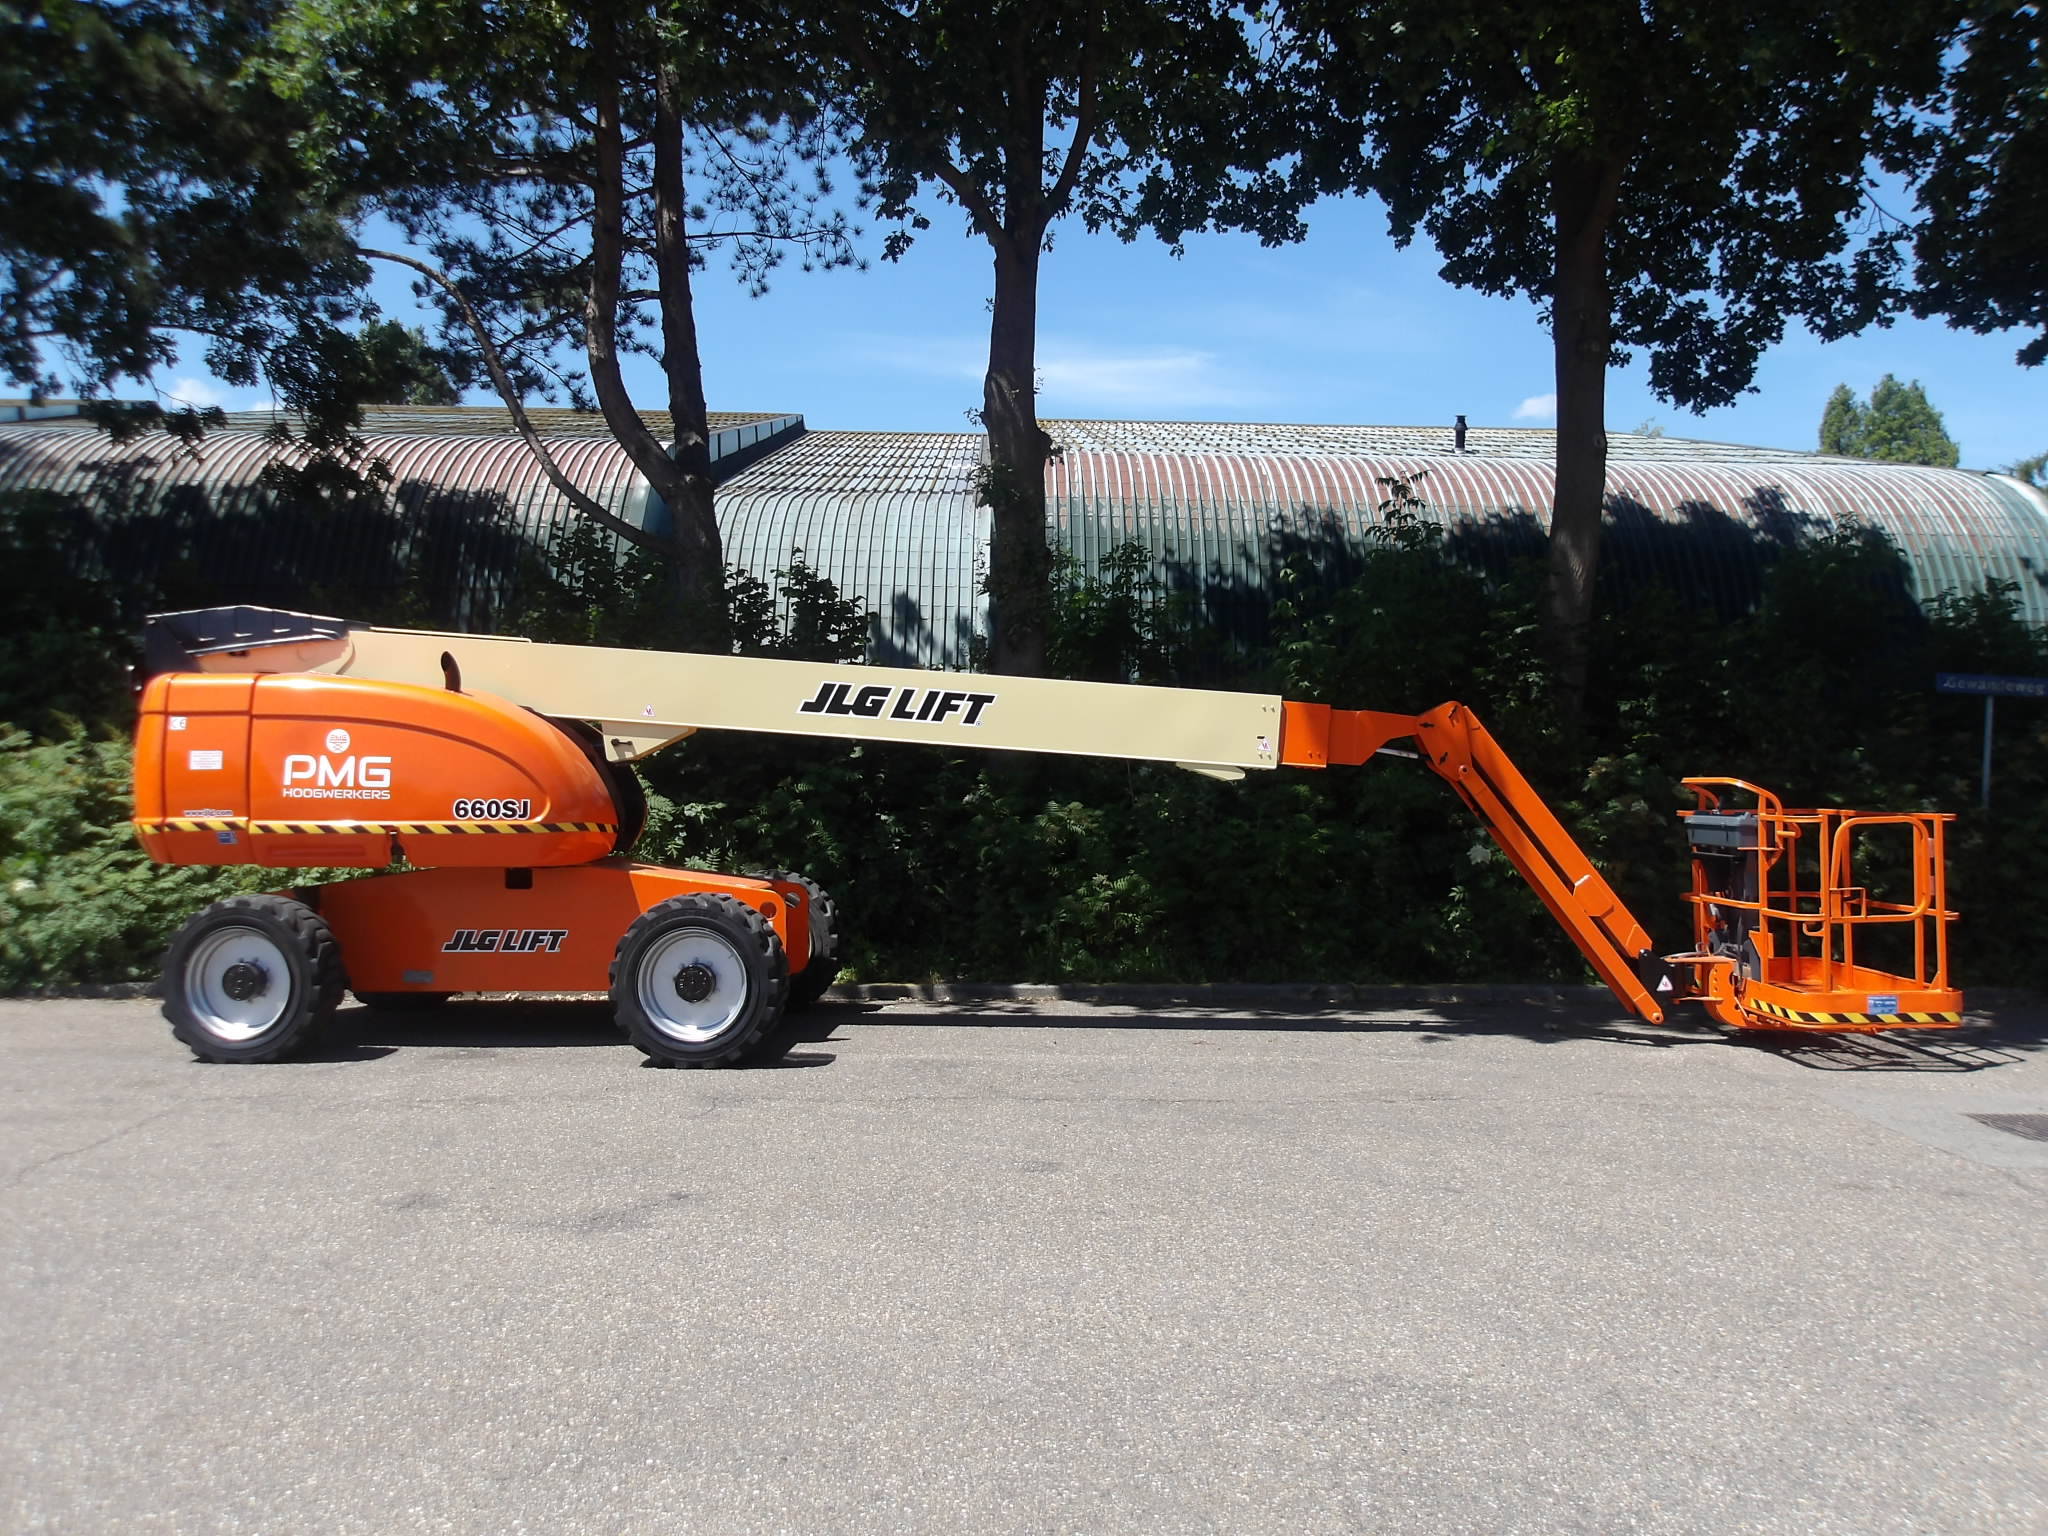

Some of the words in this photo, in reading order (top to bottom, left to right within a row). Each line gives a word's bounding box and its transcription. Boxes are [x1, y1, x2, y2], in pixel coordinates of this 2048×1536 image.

[798, 682, 893, 718] JLG
[889, 688, 996, 726] LIFT
[283, 754, 392, 788] PMG
[283, 788, 391, 800] HOOGWERKERS
[453, 798, 531, 820] 660SJ
[442, 929, 502, 952] JLG
[499, 929, 568, 952] LIFT
